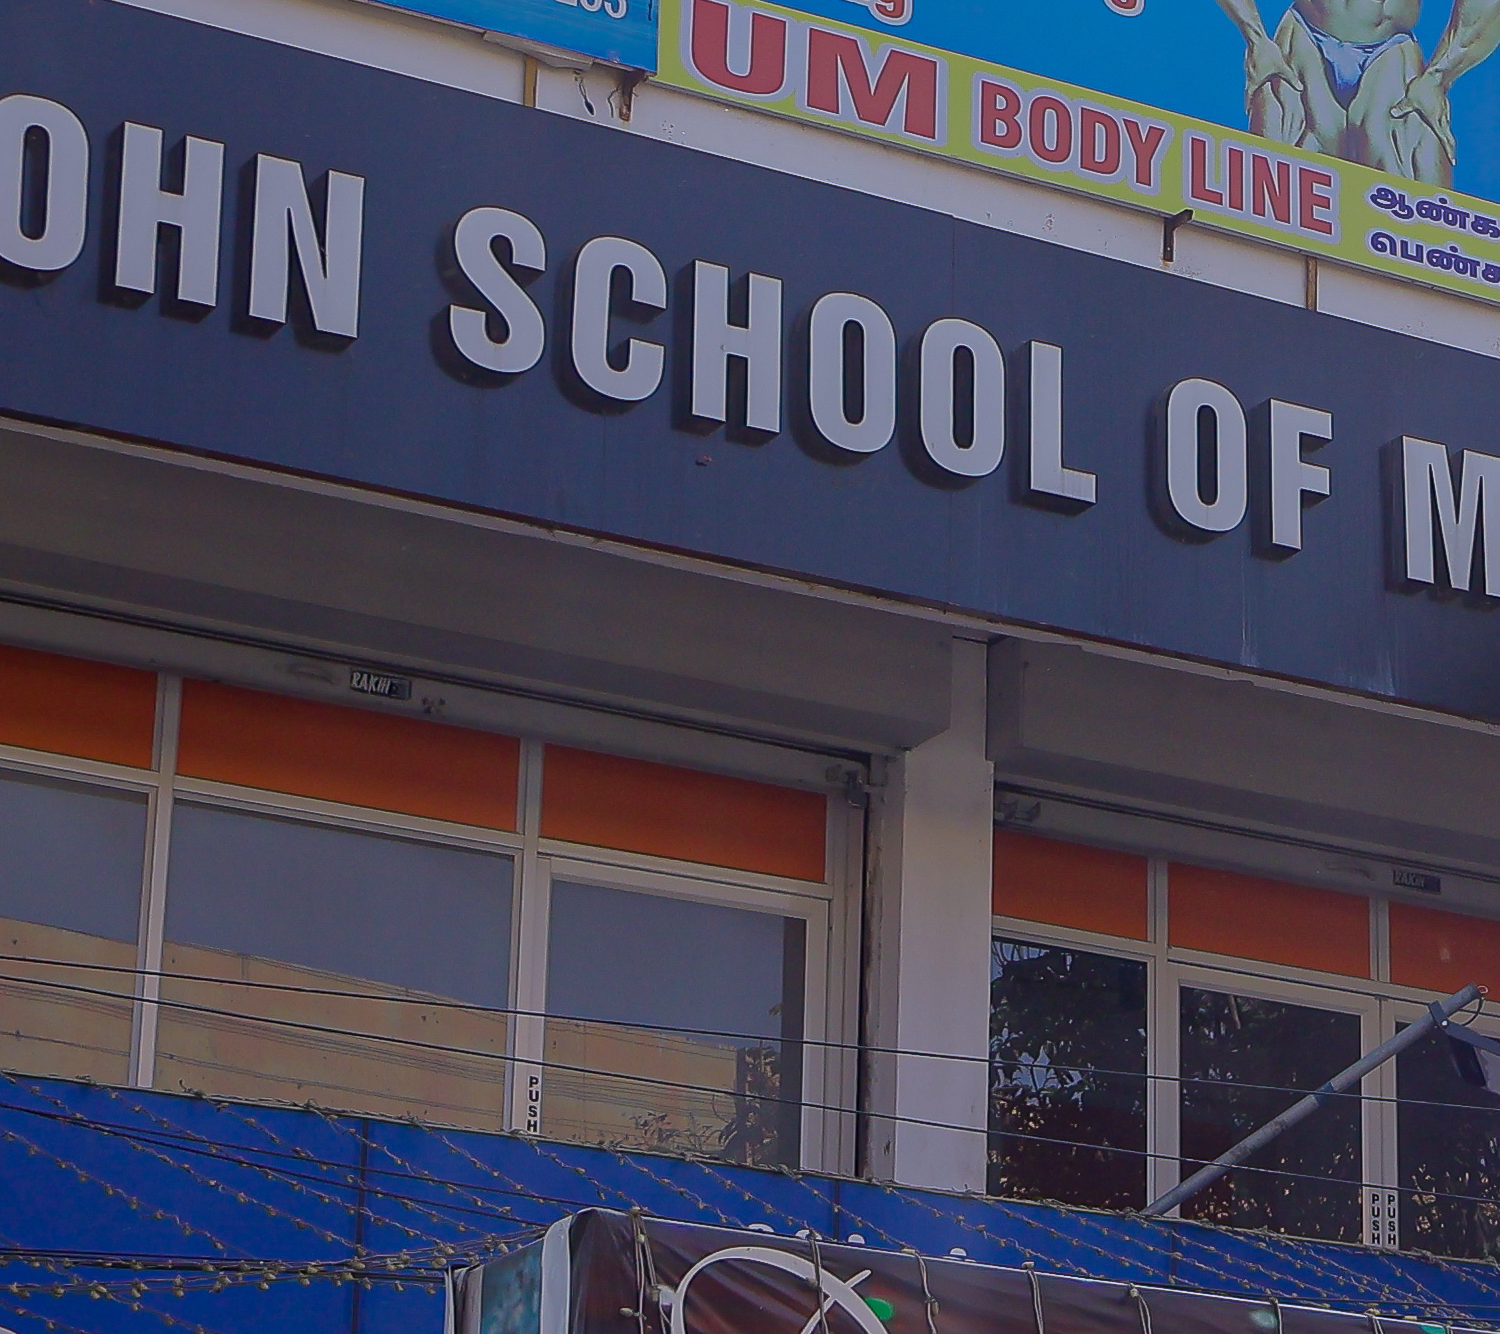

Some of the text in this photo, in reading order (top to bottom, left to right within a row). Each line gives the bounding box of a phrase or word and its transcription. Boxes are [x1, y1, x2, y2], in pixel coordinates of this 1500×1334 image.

[979, 80, 1166, 187] BODY
[1188, 135, 1336, 238] LINE
[448, 206, 1098, 504] SCHOOL
[1164, 376, 1334, 550] OF
[526, 1075, 540, 1133] PUSH
[1370, 1193, 1382, 1247] PUSH
[1385, 1192, 1398, 1247] PUSH
